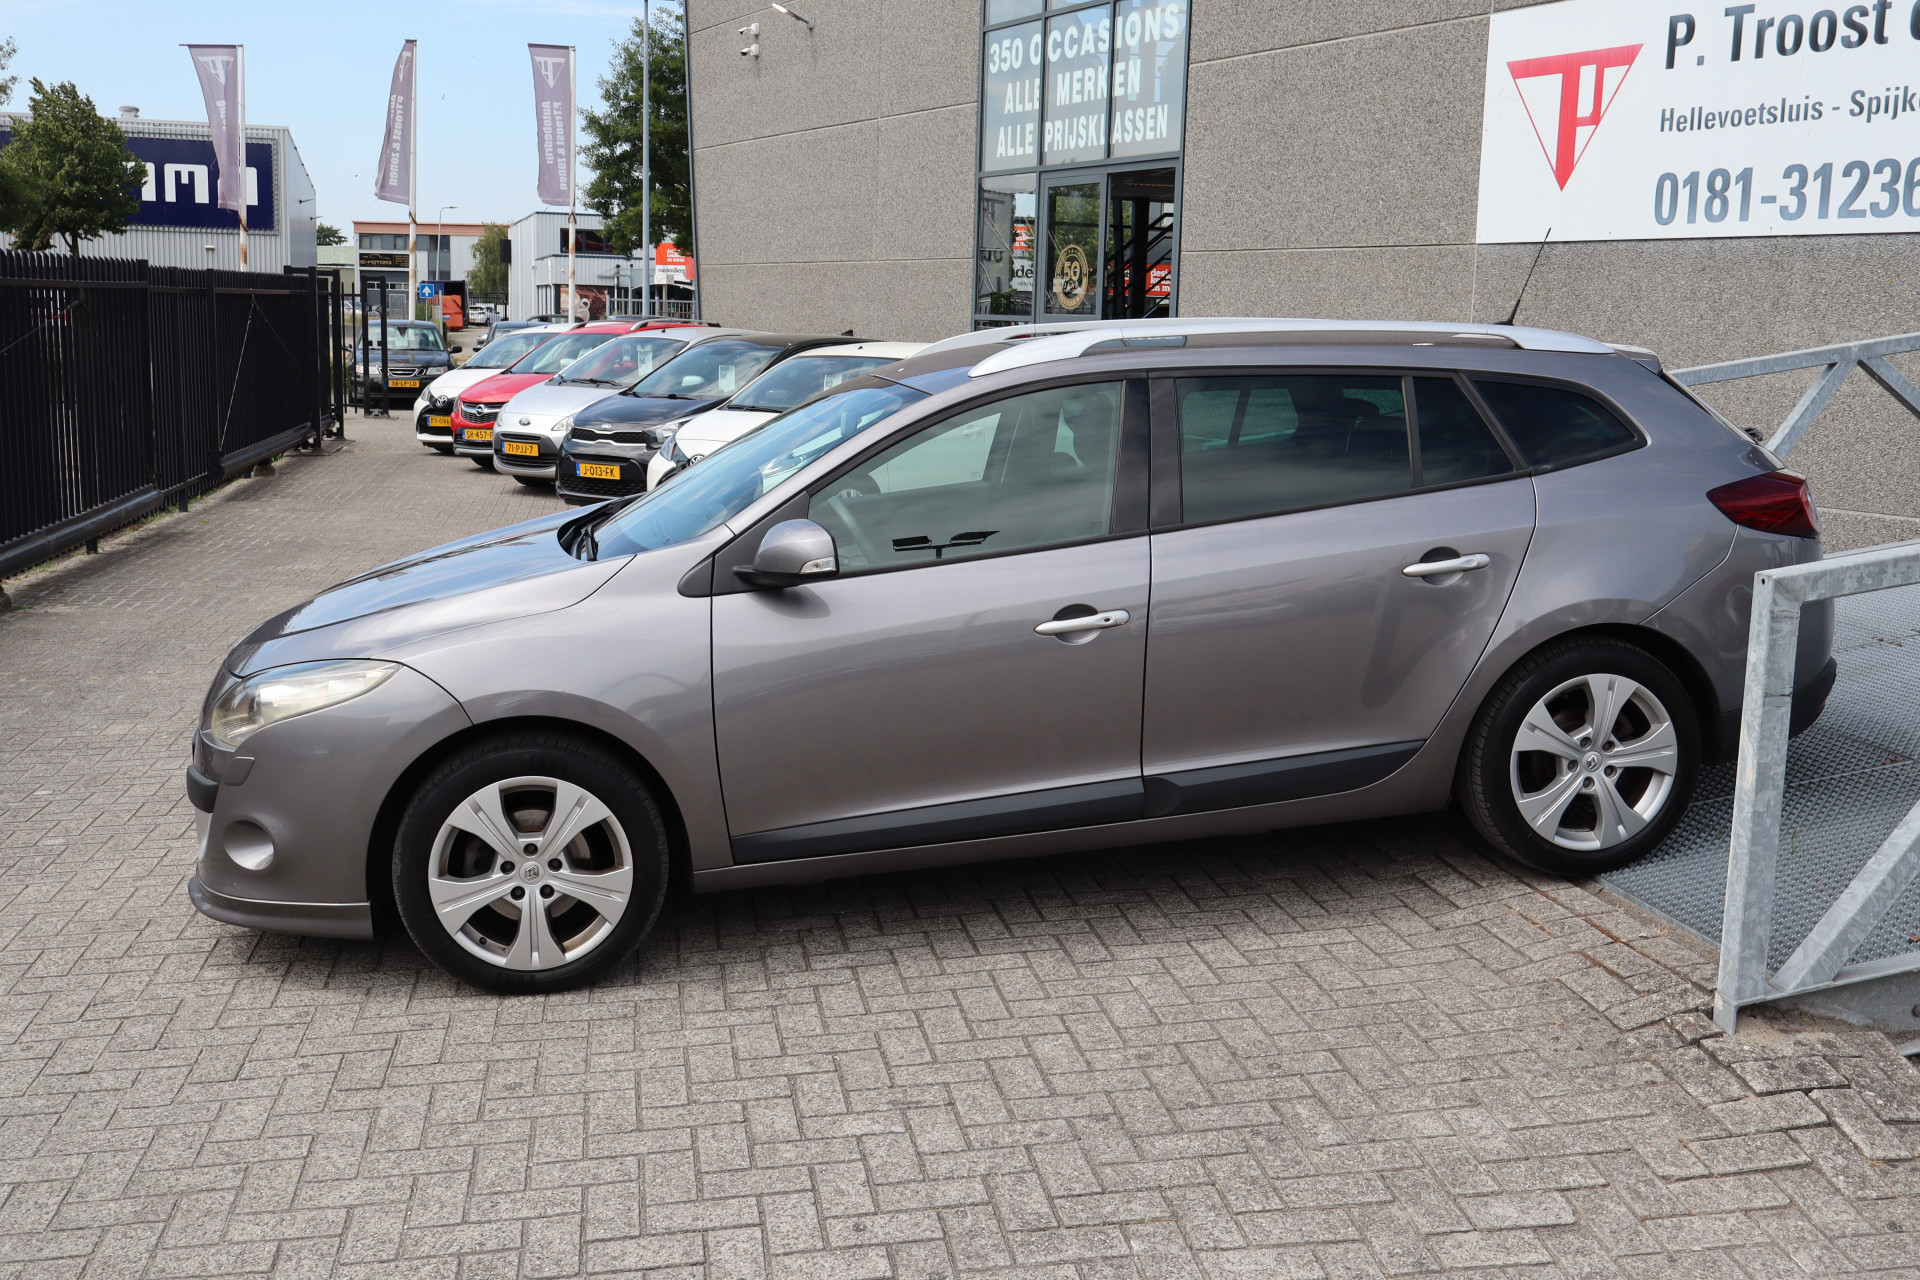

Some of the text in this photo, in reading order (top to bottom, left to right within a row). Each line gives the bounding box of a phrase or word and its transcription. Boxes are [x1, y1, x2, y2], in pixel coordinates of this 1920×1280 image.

[989, 3, 1180, 74] 350 OCCASIONS
[1665, 13, 1705, 70] P.
[1724, 0, 1893, 62] Troost
[1004, 59, 1142, 114] ALLE MERKEN
[1659, 95, 1824, 133] Hellevoetsluis
[1849, 85, 1920, 124] Spijk
[996, 104, 1169, 158] ALLE PRIJSKLASSEN
[1063, 261, 1080, 281] 50
[583, 465, 616, 479] J-013-FK
